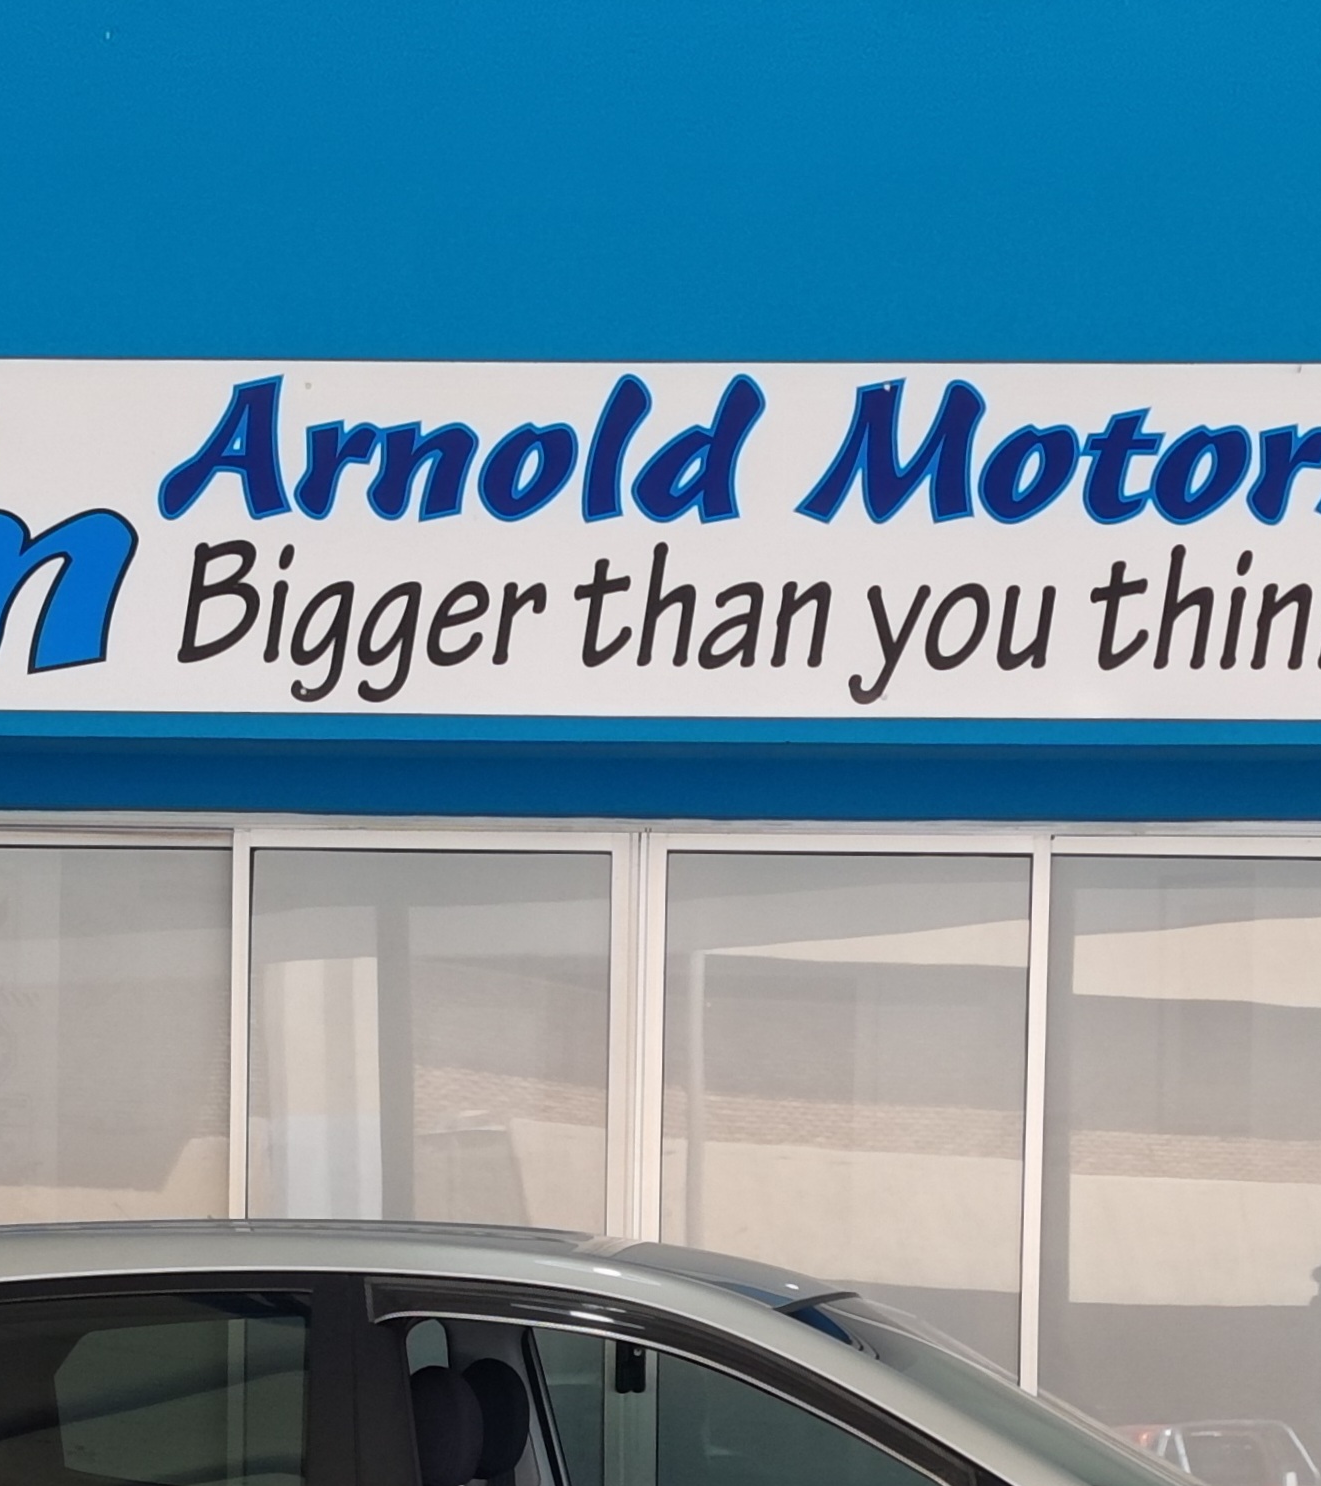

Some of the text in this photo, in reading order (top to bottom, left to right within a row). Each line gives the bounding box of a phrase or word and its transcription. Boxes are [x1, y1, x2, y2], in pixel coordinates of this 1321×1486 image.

[158, 373, 766, 524] Arnold
[177, 539, 547, 702] Bigger
[574, 541, 832, 670] than
[848, 581, 1057, 704] you
